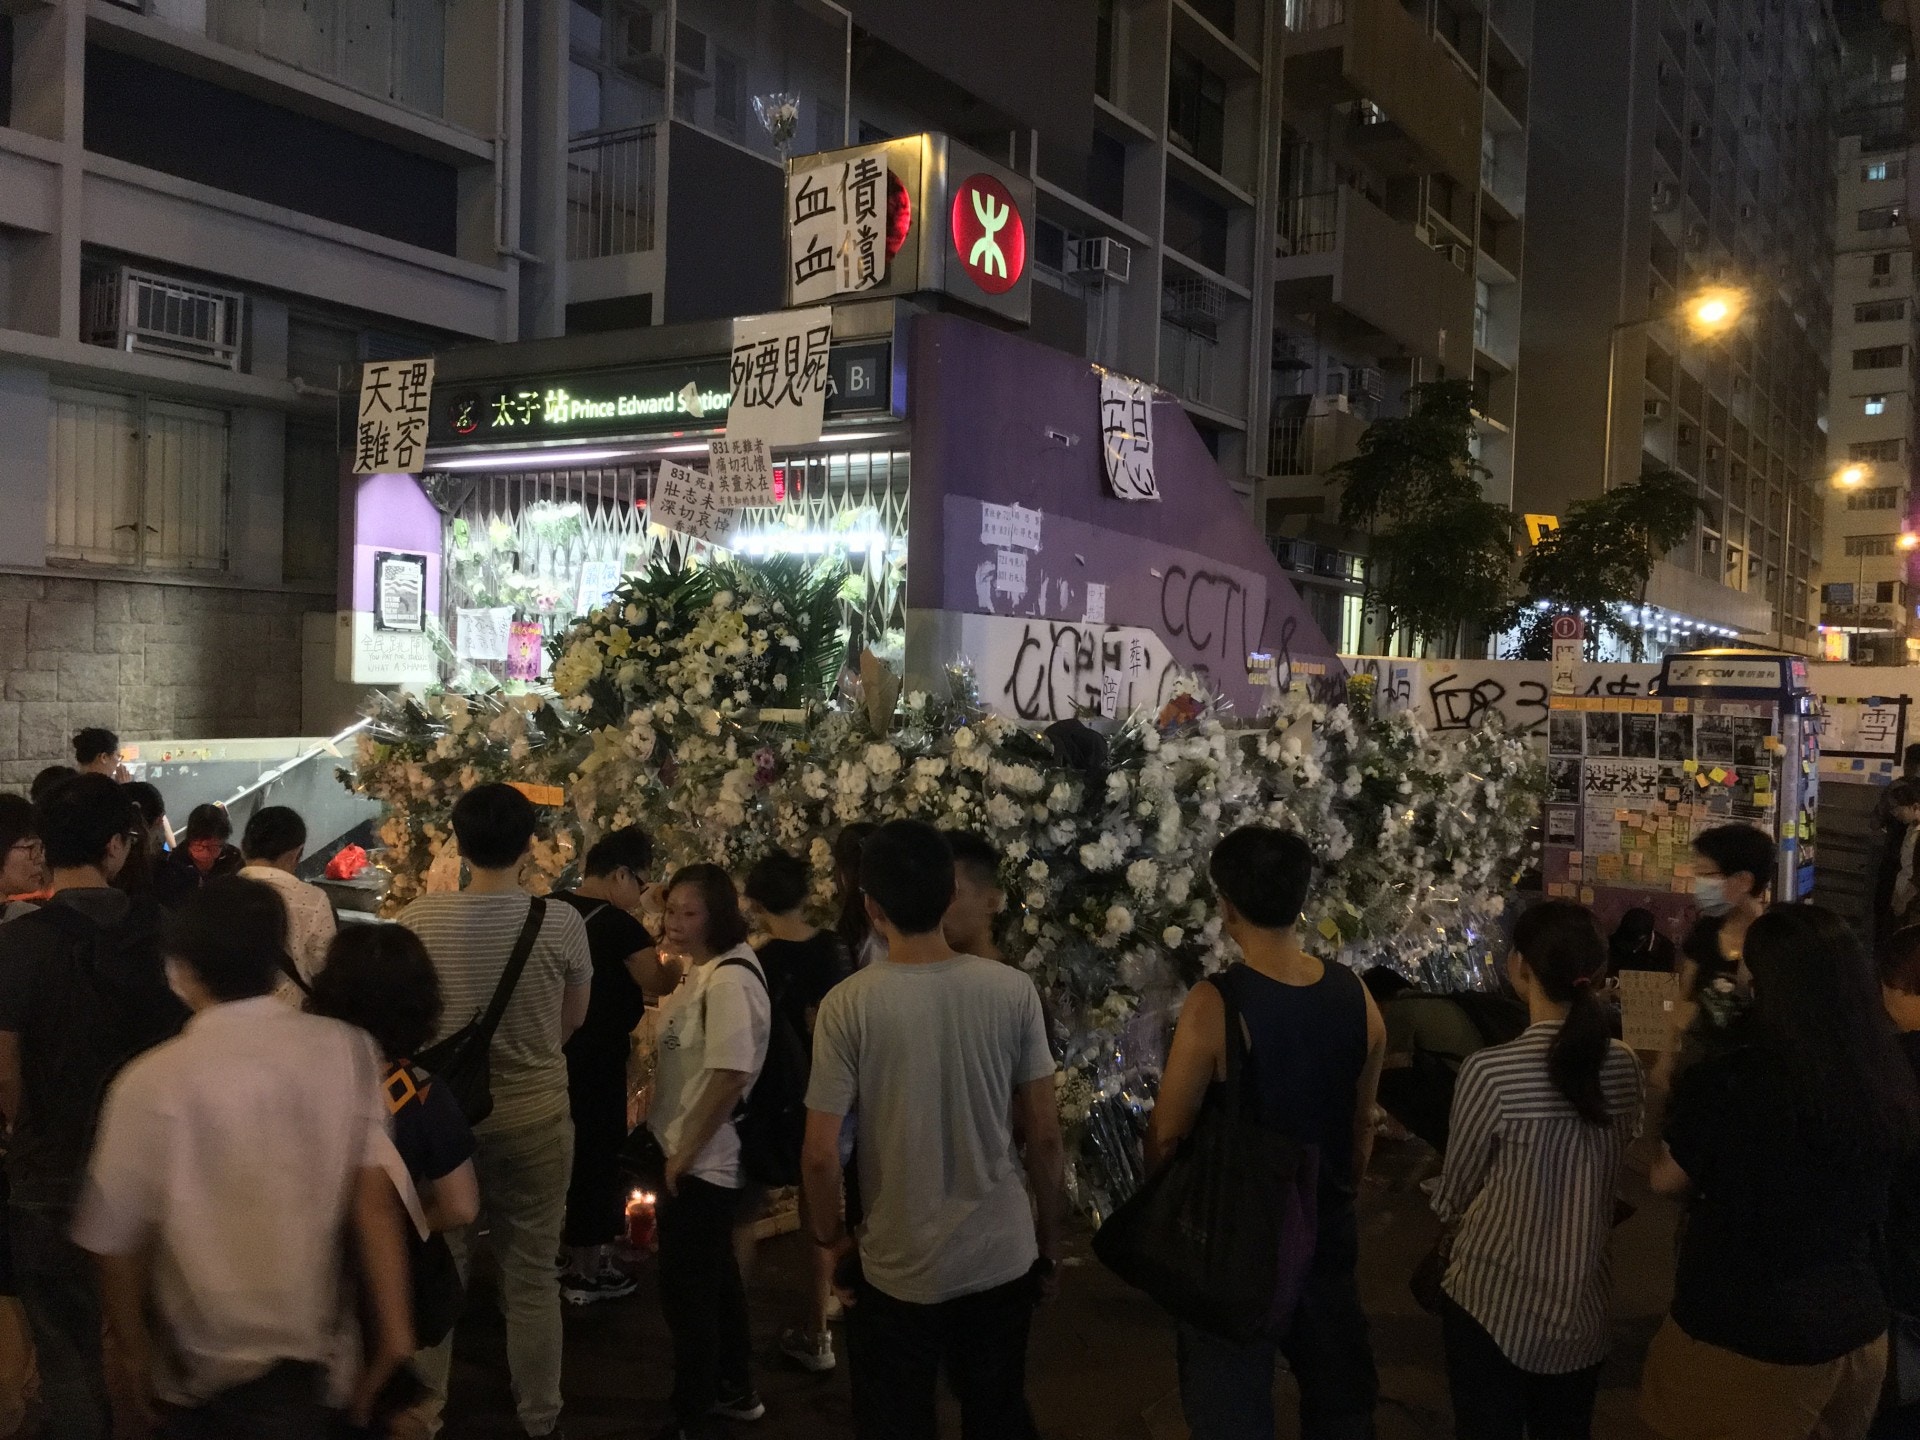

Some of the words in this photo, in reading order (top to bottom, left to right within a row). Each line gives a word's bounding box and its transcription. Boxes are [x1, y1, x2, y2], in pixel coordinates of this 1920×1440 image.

[794, 158, 882, 226] 血債
[730, 325, 831, 409] 死要見屍
[362, 363, 427, 416] 天理
[491, 389, 569, 427] 太子站
[571, 398, 615, 419] Prince
[618, 391, 674, 416] Edward
[677, 390, 731, 413] Stion
[356, 417, 426, 472] 難容
[660, 499, 730, 534] 深切哀悼
[675, 520, 711, 542] 香港人
[1695, 669, 1735, 678] PCCW
